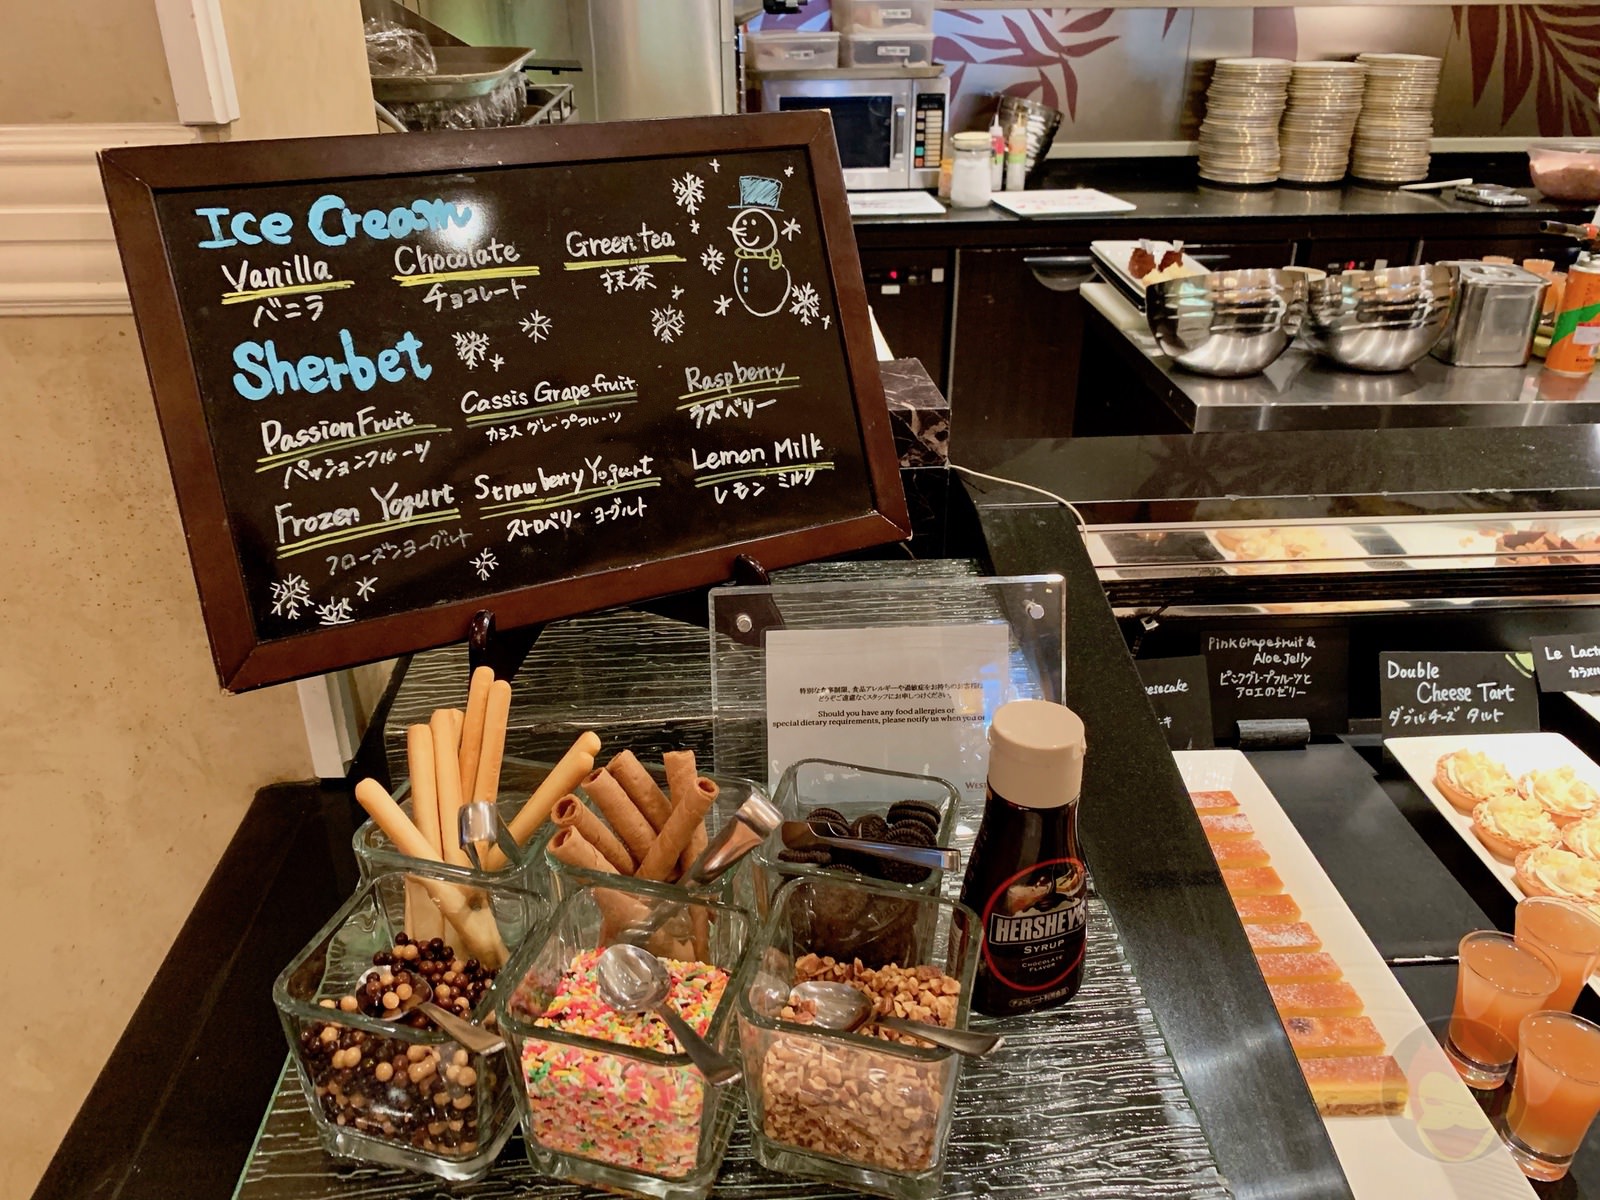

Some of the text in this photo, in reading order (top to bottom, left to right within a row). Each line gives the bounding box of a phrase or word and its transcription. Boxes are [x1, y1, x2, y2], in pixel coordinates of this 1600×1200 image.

[195, 194, 472, 248] Ice Cream
[394, 237, 521, 275] Chocolate
[565, 222, 676, 258] Green tea
[221, 254, 334, 292] Vanilla
[600, 264, 657, 294] 抹茶
[252, 294, 324, 328] バニラ
[422, 278, 527, 313] チョコレート
[232, 328, 433, 401] Sherbet
[684, 360, 787, 394] Raspberry
[460, 390, 530, 415] Cassis
[260, 405, 416, 456] Passion Fruit
[283, 439, 432, 491] パッションフルーツ
[691, 432, 825, 471] Lemon Milk
[583, 454, 654, 489] Yogurt
[713, 468, 816, 505] レモン ミルク
[274, 481, 455, 544] Frozen Yogurt
[506, 510, 582, 543] ストロベリー
[325, 527, 474, 577] フローズンヨーグルト
[1208, 635, 1317, 652] Pink Grapefruit &
[1252, 652, 1313, 669] Aloe Jelly
[1544, 646, 1563, 661] Le
[1387, 659, 1440, 680] Double
[1235, 685, 1308, 700] アロエのゼリー
[1416, 681, 1516, 704] Cheese Tart
[772, 720, 799, 729] special
[800, 719, 828, 727] dietary
[828, 717, 881, 727] requirements,
[882, 716, 907, 725] please
[906, 715, 930, 724] notify
[817, 709, 845, 718] Should
[846, 710, 860, 718] you
[861, 708, 879, 716] have
[880, 709, 895, 717] any
[895, 707, 914, 715] food
[914, 707, 946, 716] allergies
[965, 781, 987, 790] WEST
[1021, 955, 1064, 969] CHOCOLATE
[1023, 939, 1065, 955] SYRUP
